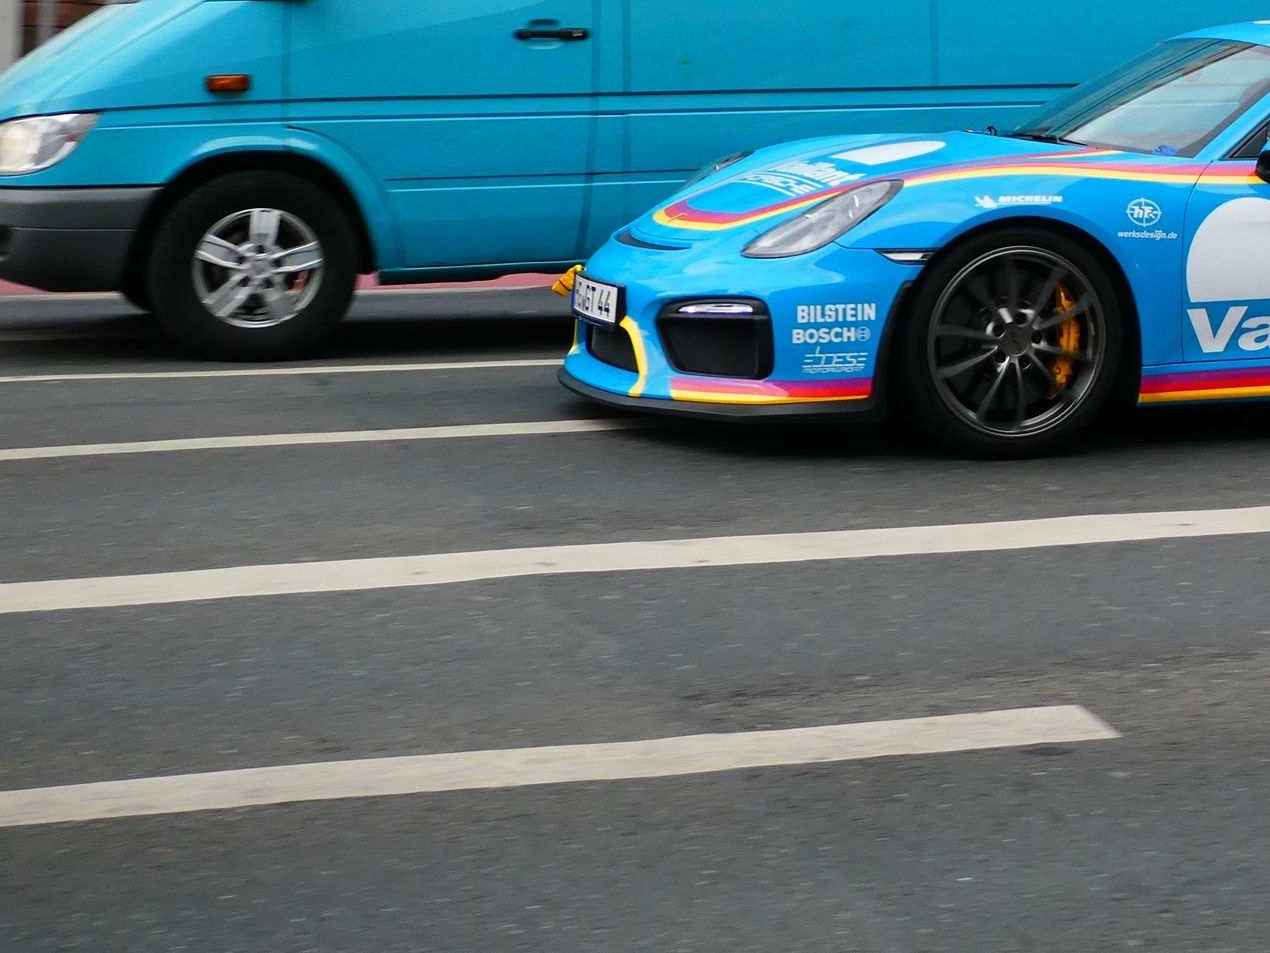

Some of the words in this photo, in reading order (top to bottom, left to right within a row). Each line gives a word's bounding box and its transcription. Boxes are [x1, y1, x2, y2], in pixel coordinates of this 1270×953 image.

[998, 194, 1064, 203] MICHELIN
[597, 288, 611, 318] 44
[797, 302, 877, 324] BILSTEIN
[791, 326, 857, 345] BOSCH
